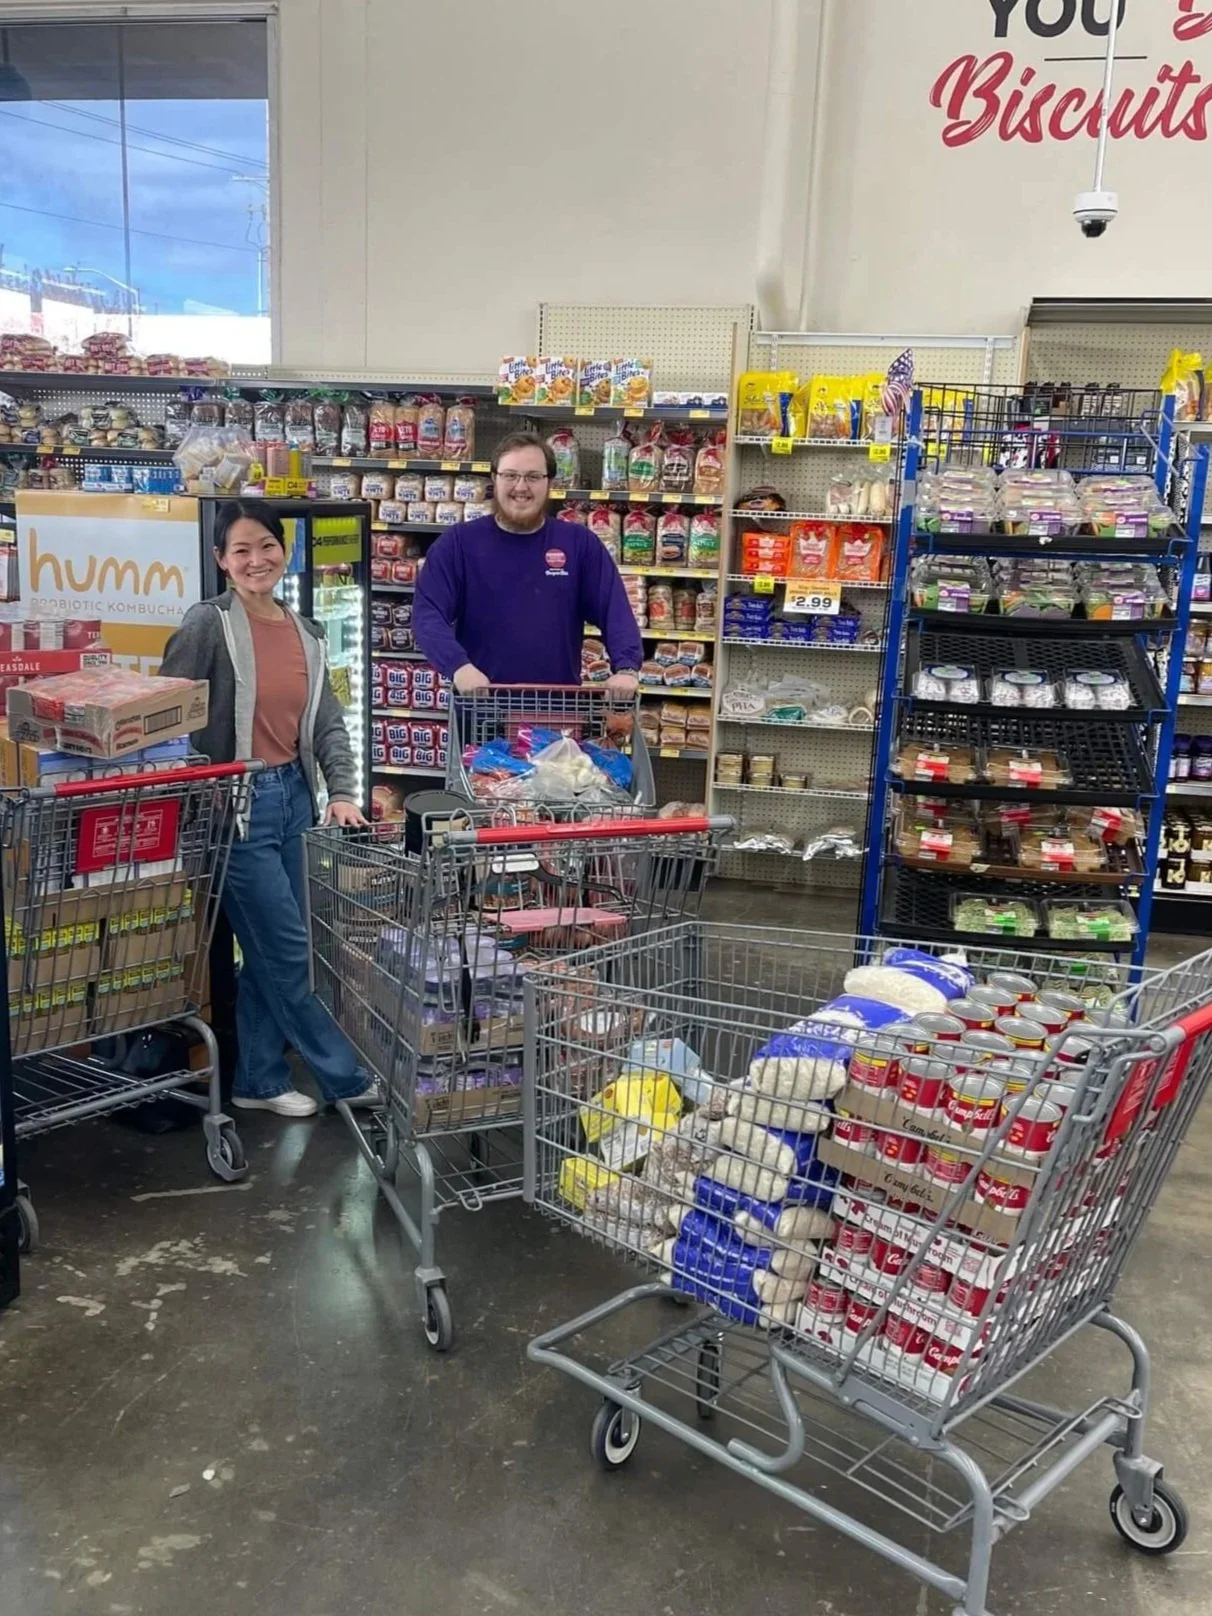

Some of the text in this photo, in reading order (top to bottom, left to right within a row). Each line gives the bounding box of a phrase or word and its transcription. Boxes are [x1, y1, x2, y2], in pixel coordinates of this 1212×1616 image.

[989, 0, 1126, 38] YOU
[929, 51, 1212, 147] Biscuits
[29, 528, 184, 598] humm
[791, 595, 832, 608] $2.99
[107, 602, 184, 615] KOMBUCHA
[0, 663, 40, 672] EASDALE
[389, 673, 406, 684] BIG
[414, 673, 432, 684] BIG
[415, 691, 432, 702] BIG
[389, 729, 406, 740] BIG
[413, 731, 431, 742] BIG
[392, 747, 409, 759] BIG
[416, 750, 434, 762] BIG
[892, 1297, 938, 1326] ushroom
